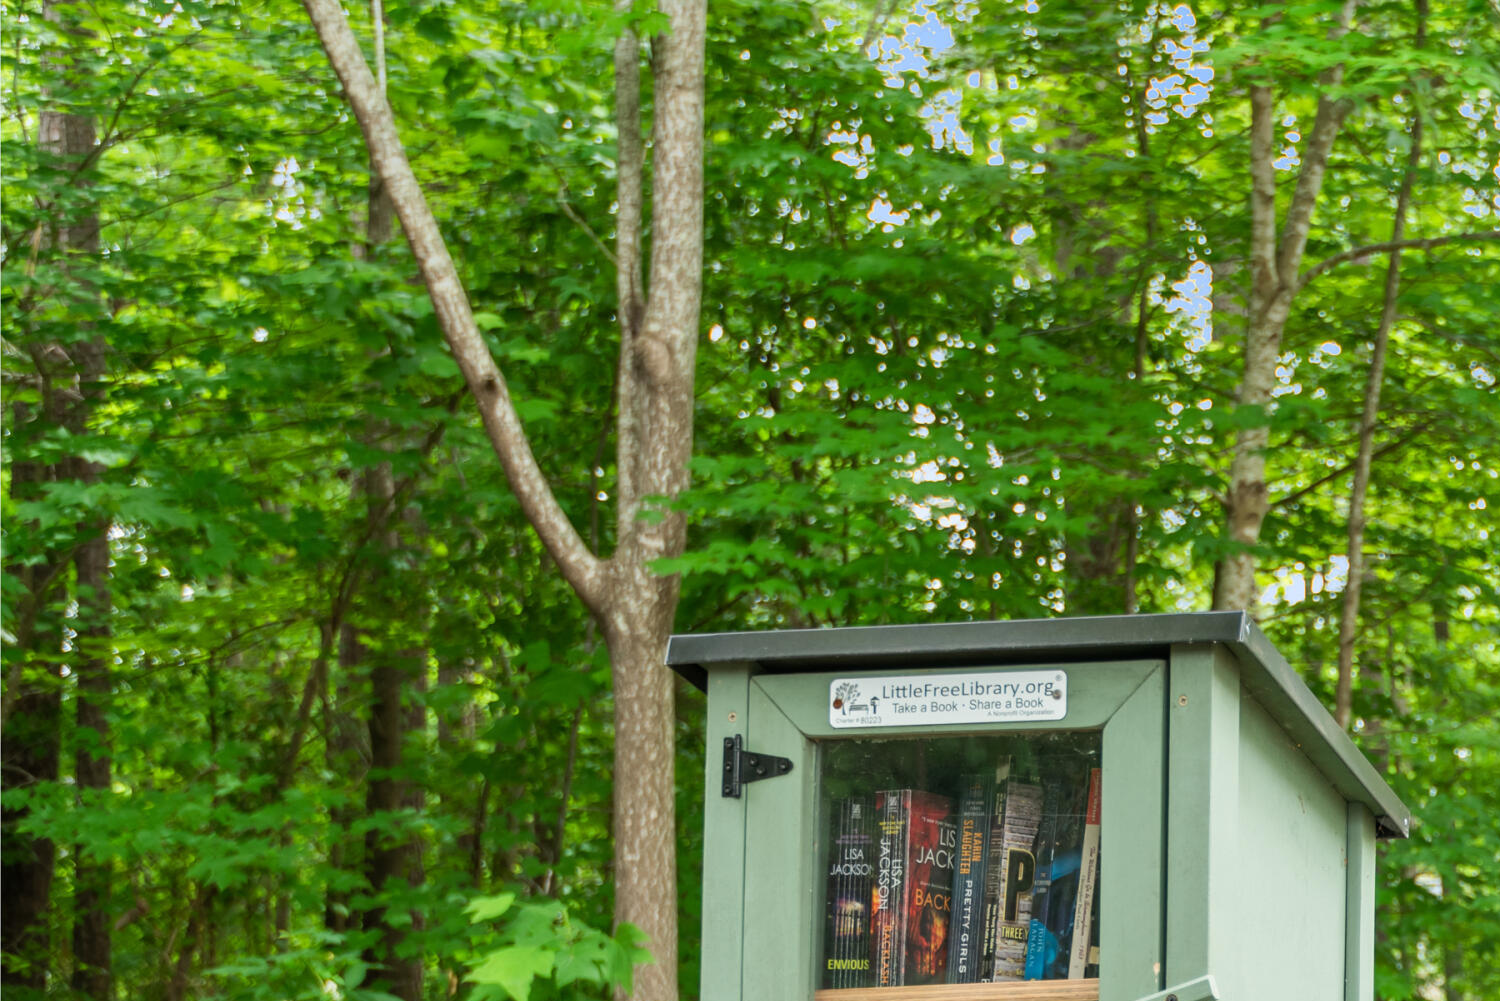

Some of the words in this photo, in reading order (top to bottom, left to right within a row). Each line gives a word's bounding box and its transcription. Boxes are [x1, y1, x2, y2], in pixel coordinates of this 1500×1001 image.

[882, 681, 1055, 699] LittleFreeLibrary.org
[892, 702, 917, 713] Take
[920, 704, 927, 713] a
[930, 701, 958, 713] Book
[969, 699, 1002, 710] Share
[1005, 701, 1012, 710] a
[1015, 697, 1044, 709] Book
[844, 848, 864, 860] LISA
[960, 819, 974, 875] SLAUGHTER
[972, 832, 983, 862] KARIN
[830, 863, 874, 876] JACKSON
[878, 838, 890, 911] JACKSON
[891, 859, 902, 888] LISA
[963, 880, 973, 929] PRETTY
[1001, 926, 1024, 939] THREE
[827, 959, 870, 970] ENVIOUS
[958, 933, 970, 974] GIRLS
